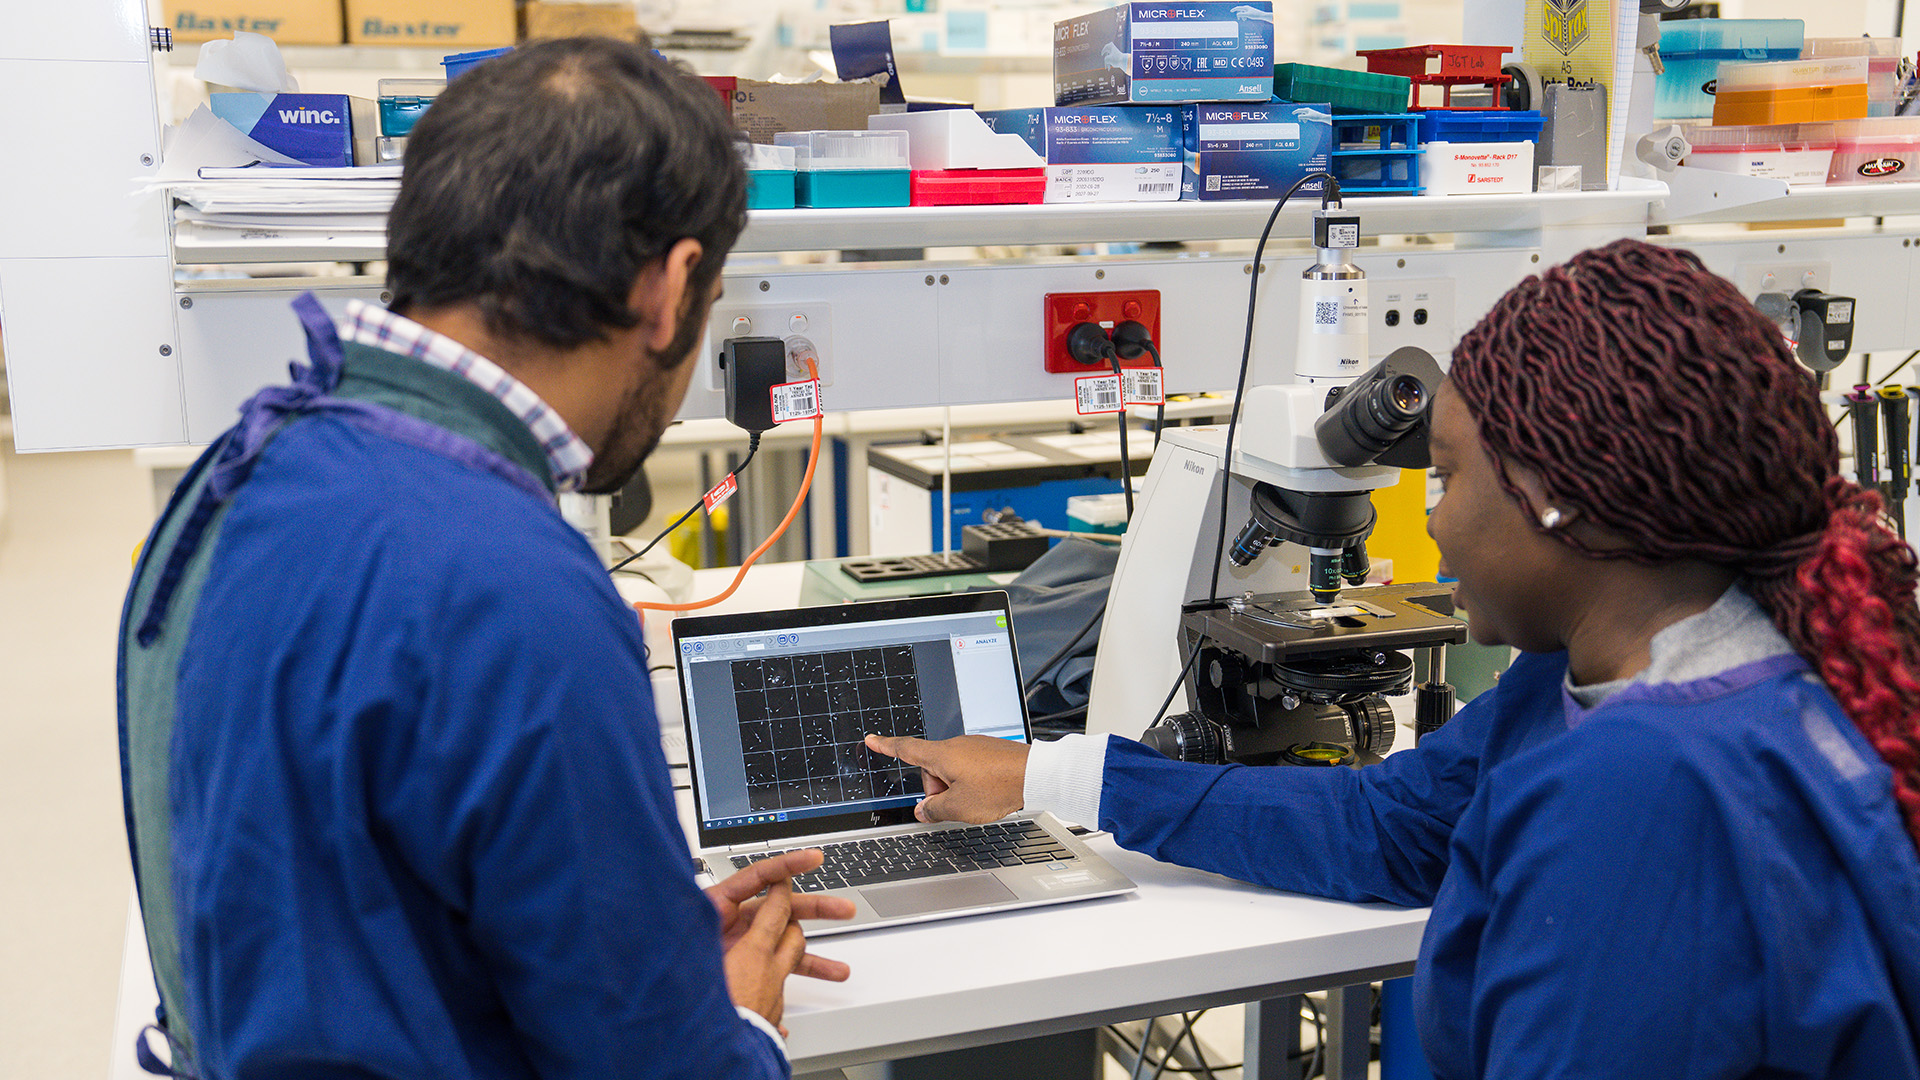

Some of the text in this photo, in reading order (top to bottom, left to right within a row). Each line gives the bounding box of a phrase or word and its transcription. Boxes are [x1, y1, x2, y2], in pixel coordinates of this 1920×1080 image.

[1138, 9, 1206, 19] MICROFLEX
[175, 11, 283, 34] Baxter
[362, 17, 463, 38] Baxter
[1543, 3, 1588, 43] Spirax
[1246, 57, 1264, 68] 0493
[1471, 57, 1485, 68] Lab
[1561, 60, 1572, 74] A5
[1238, 84, 1262, 93] Ansell
[278, 106, 340, 124] winc.
[1054, 115, 1118, 124] MICROFLEX
[1145, 113, 1173, 123] 7½-8
[1205, 111, 1270, 121] MICROFLEX
[1300, 181, 1323, 190] Ansell
[1183, 459, 1205, 475] Nikon
